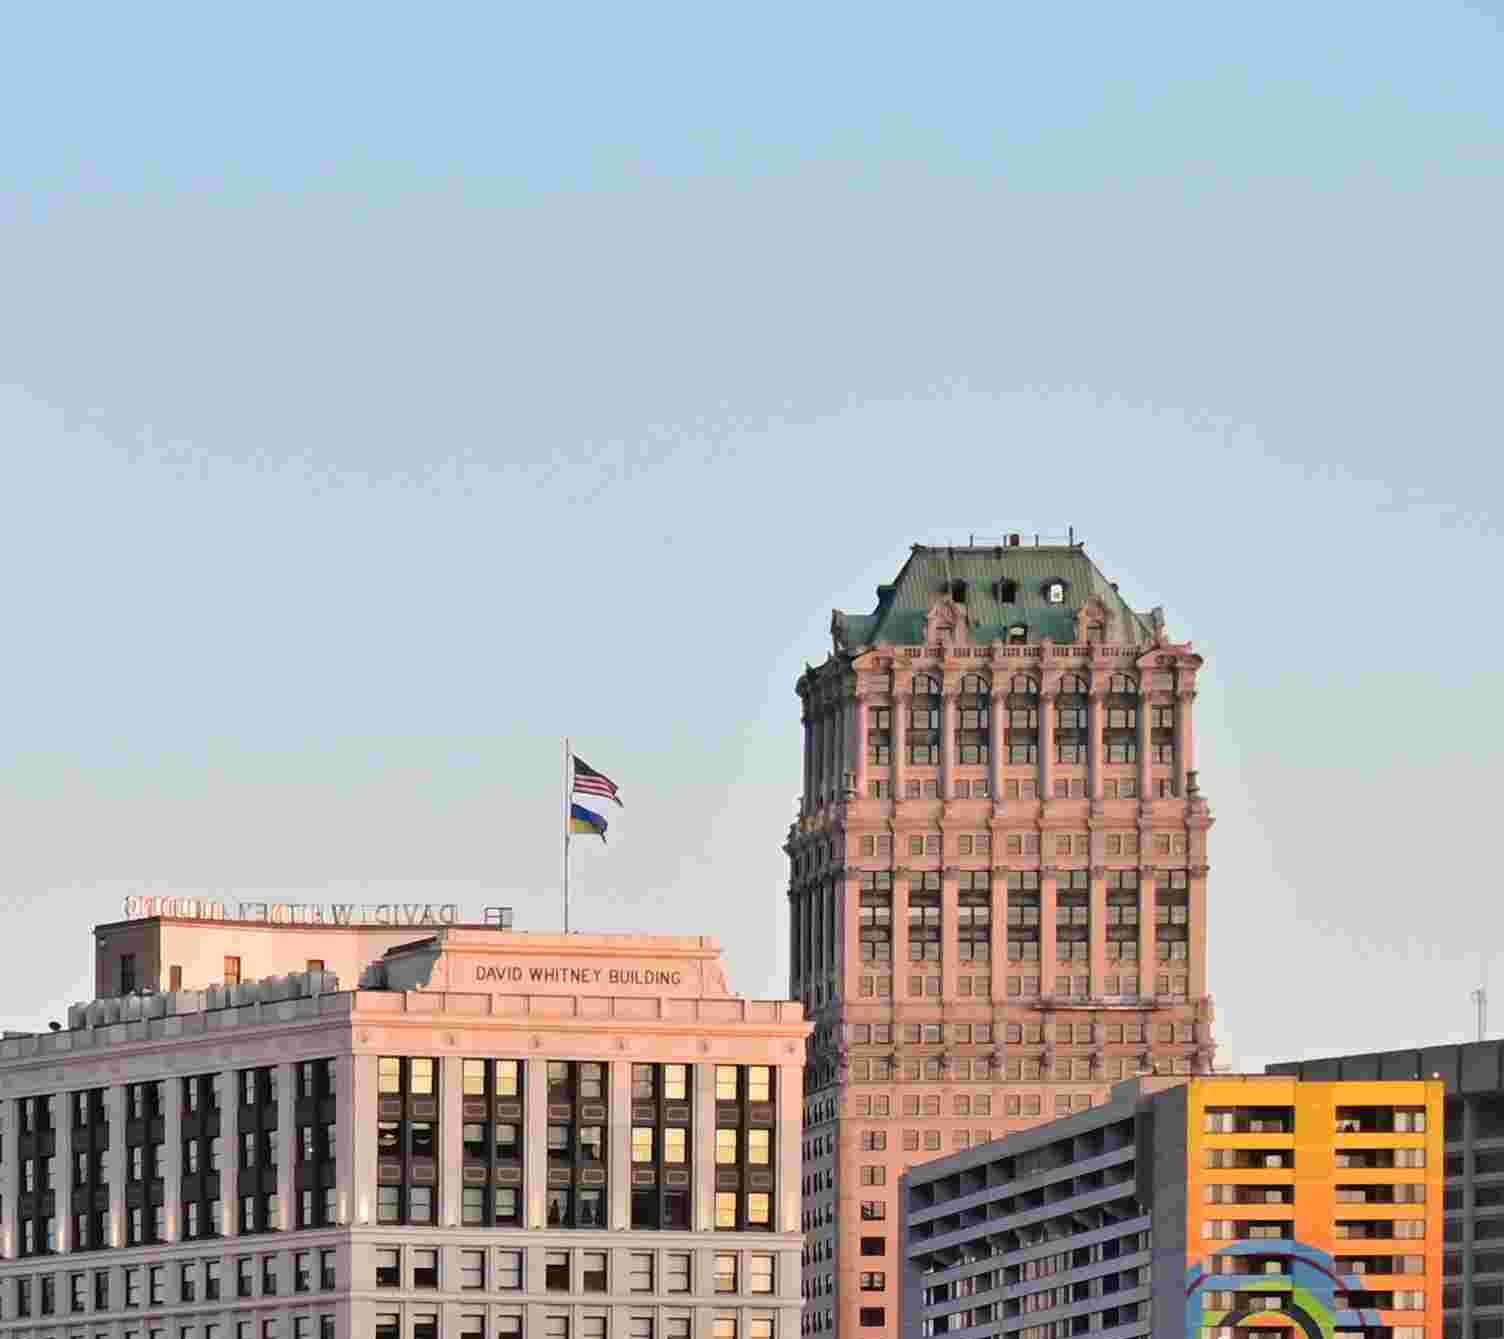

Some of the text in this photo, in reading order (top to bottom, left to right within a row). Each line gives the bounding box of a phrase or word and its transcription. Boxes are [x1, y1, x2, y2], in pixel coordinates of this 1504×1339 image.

[475, 966, 681, 984] DAVID WHITNEY BUILDING
